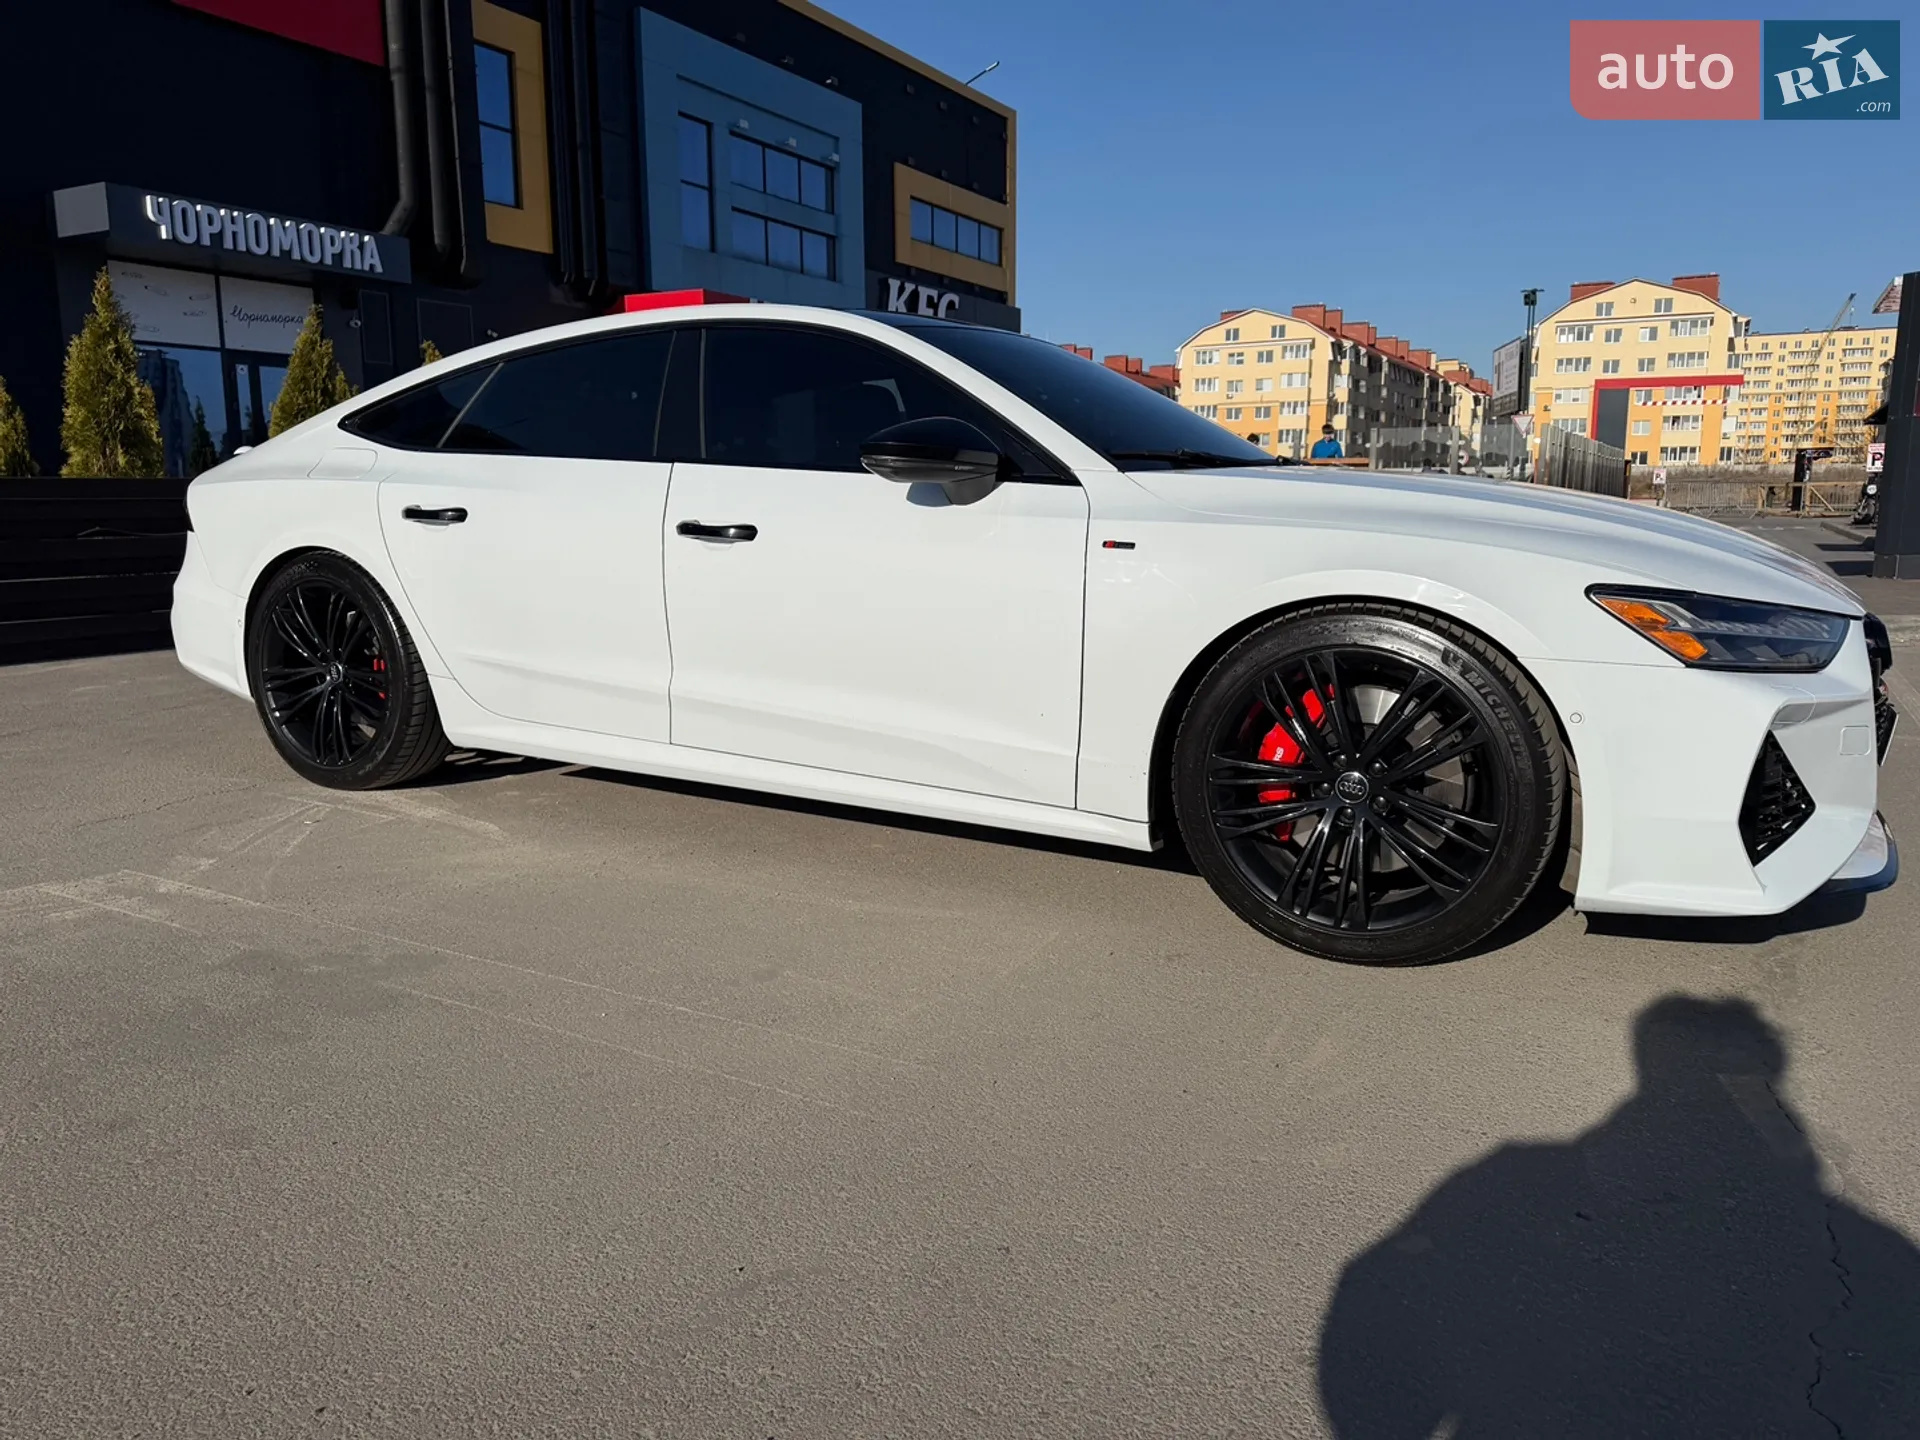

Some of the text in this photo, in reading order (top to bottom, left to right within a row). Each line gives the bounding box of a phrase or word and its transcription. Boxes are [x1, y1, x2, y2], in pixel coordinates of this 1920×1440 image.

[146, 195, 383, 273] ЧОРНОМОРКА
[888, 278, 959, 318] KFC
[1464, 670, 1532, 769] MICHELIN
